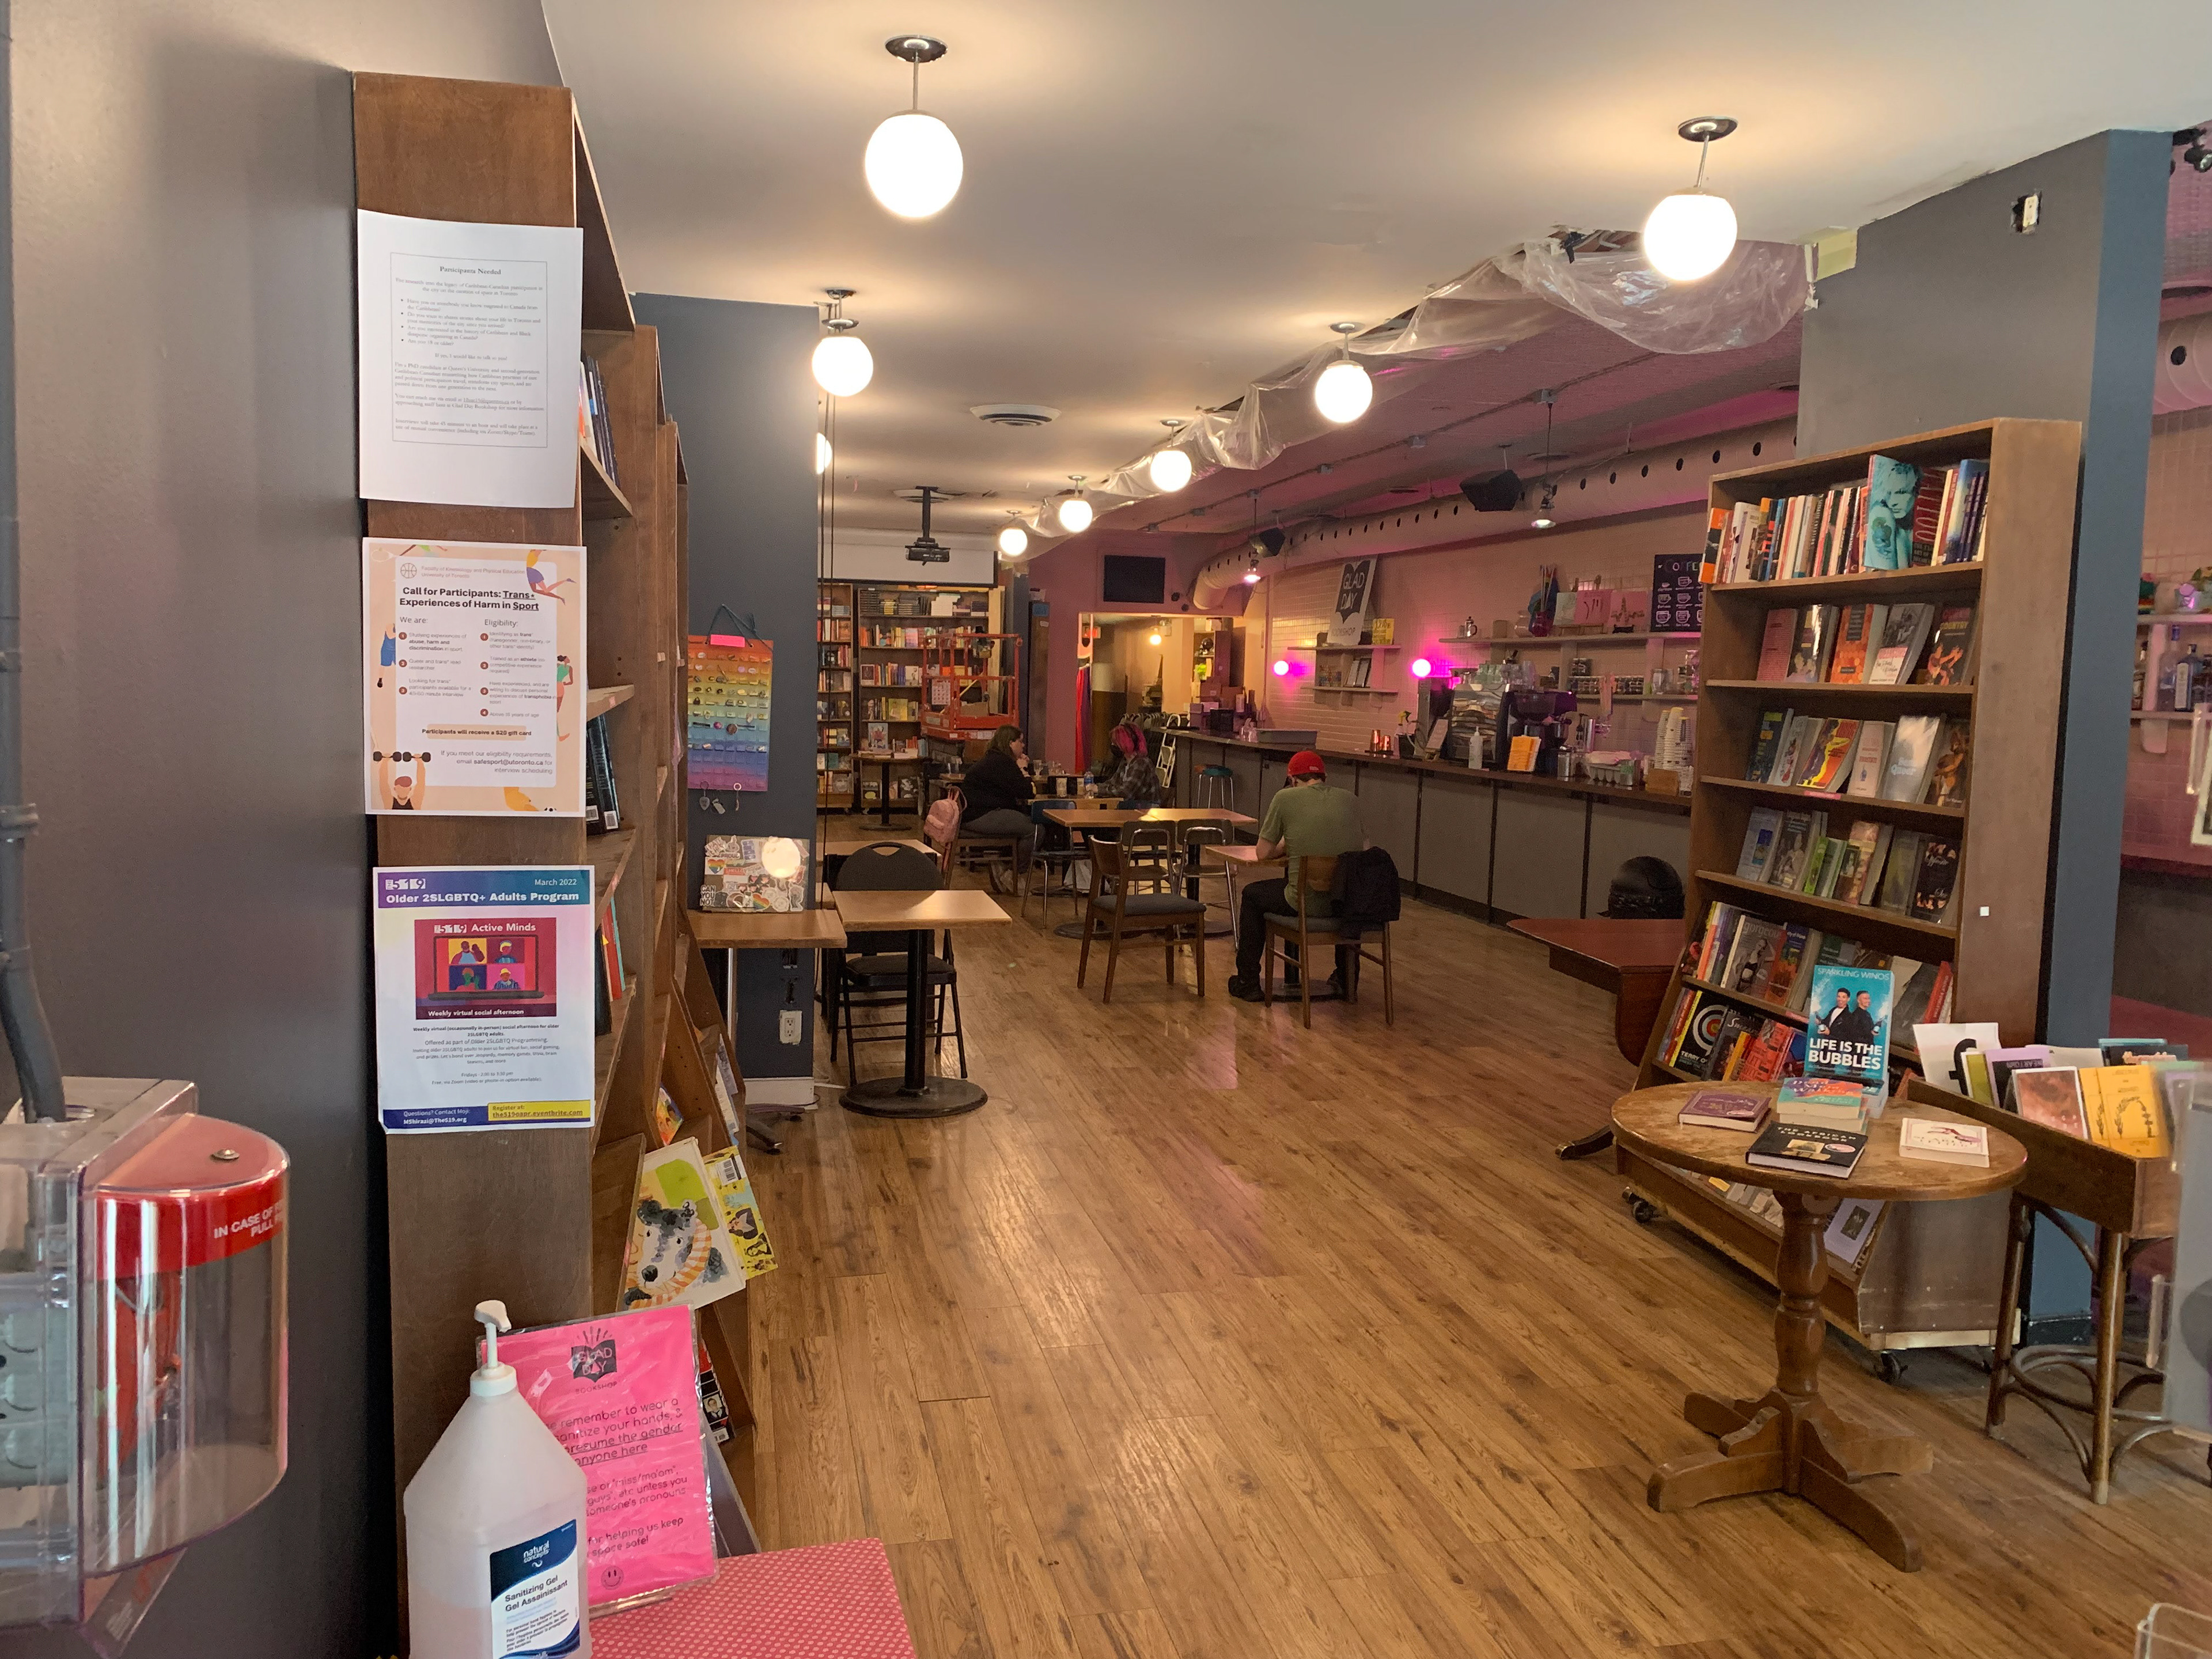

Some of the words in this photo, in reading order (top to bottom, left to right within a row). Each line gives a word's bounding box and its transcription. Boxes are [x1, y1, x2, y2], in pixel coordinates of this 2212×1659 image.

[1343, 572, 1365, 589] GLAD
[440, 588, 501, 598] Participants:
[1340, 592, 1358, 610] DAY
[400, 599, 460, 607] Experiences
[513, 603, 539, 611] Sport
[484, 619, 518, 628] Eligibility:
[387, 895, 419, 903] Older
[423, 893, 486, 903] 2SLGBTQ+
[490, 893, 527, 901] Adults
[531, 893, 578, 903] Program
[471, 923, 502, 932] Active
[506, 923, 536, 931] Minds
[1743, 921, 1785, 938] gorgeou
[1817, 968, 1859, 978] SPARKLING
[1861, 972, 1889, 980] WINOS
[1810, 1037, 1837, 1051] LIFE
[1840, 1041, 1852, 1052] IS
[1855, 1043, 1883, 1056] THE
[1808, 1050, 1881, 1070] BUBBLES
[404, 1109, 433, 1118] Questions?
[214, 1225, 228, 1238] IN
[231, 1213, 260, 1232] CASE
[262, 1206, 274, 1220] OF
[251, 1219, 274, 1237] PULL
[578, 1347, 613, 1363] GLAD
[582, 1361, 608, 1375] DAY
[575, 1381, 617, 1395] BOOKSHOP
[561, 1408, 621, 1427] remember
[626, 1406, 637, 1415] to
[641, 1400, 667, 1411] wear
[555, 1426, 600, 1441] sanitize
[604, 1421, 630, 1435] your
[634, 1411, 672, 1427] hands,
[676, 1408, 683, 1418] &
[618, 1432, 637, 1442] the
[641, 1422, 682, 1440] gender
[574, 1449, 617, 1465] anyone
[622, 1443, 647, 1454] here
[637, 1481, 667, 1494] unless
[671, 1477, 687, 1486] you
[639, 1487, 686, 1503] pronouns
[588, 1535, 603, 1545] for
[606, 1527, 644, 1540] helping
[646, 1524, 658, 1532] us
[661, 1517, 683, 1529] keep
[524, 1540, 550, 1558] natural
[592, 1543, 622, 1556] space
[626, 1536, 649, 1548] safe!
[524, 1549, 550, 1563] concepts
[505, 1583, 544, 1602] Sanitizing
[546, 1575, 558, 1586] Gel
[505, 1601, 519, 1612] Gel
[521, 1580, 567, 1607] Assainissant
